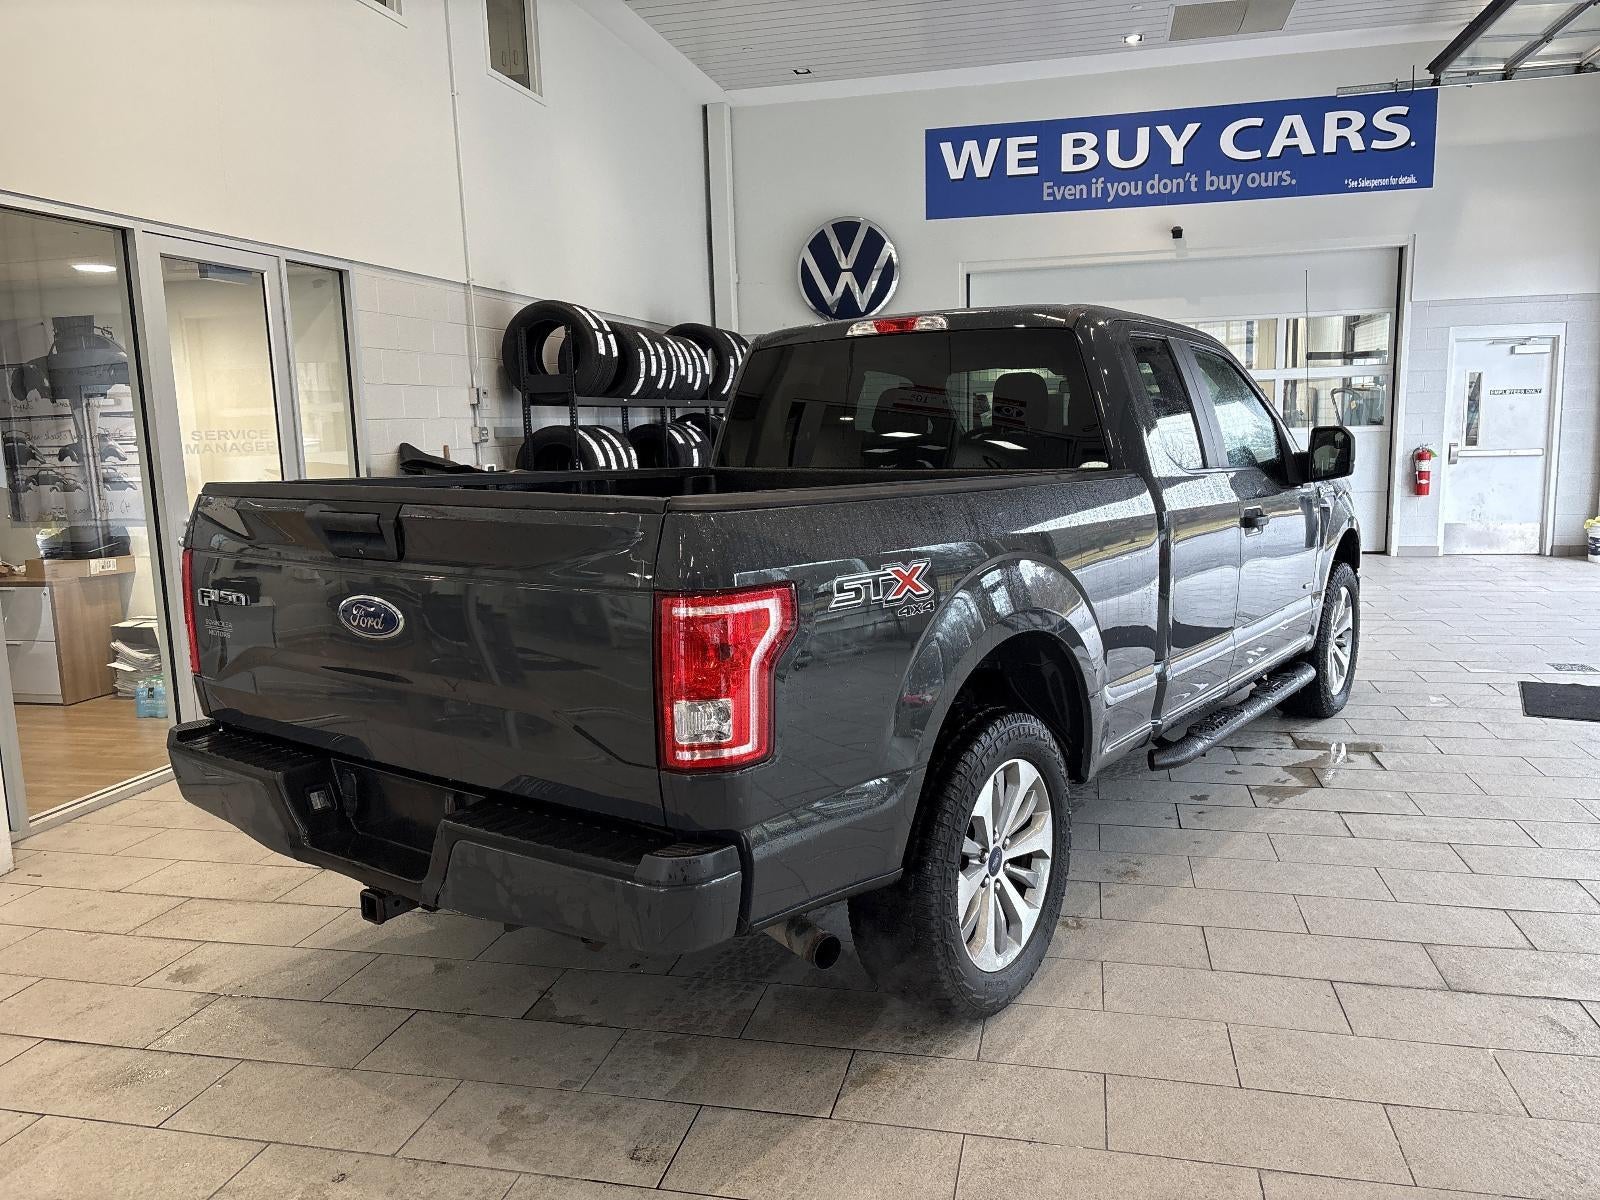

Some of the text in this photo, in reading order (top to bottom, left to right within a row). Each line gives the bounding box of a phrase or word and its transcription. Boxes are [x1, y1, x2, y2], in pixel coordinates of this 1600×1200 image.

[939, 105, 1417, 181] WE BUY CARS.
[1043, 168, 1297, 203] Even if you don't buy ours.
[1358, 176, 1389, 189] Salesperson
[1389, 175, 1398, 185] for
[1398, 173, 1418, 185] details.
[184, 441, 278, 455] MANAGER
[191, 429, 272, 441] SERVICE
[828, 558, 934, 612] STX
[350, 602, 385, 631] Ford
